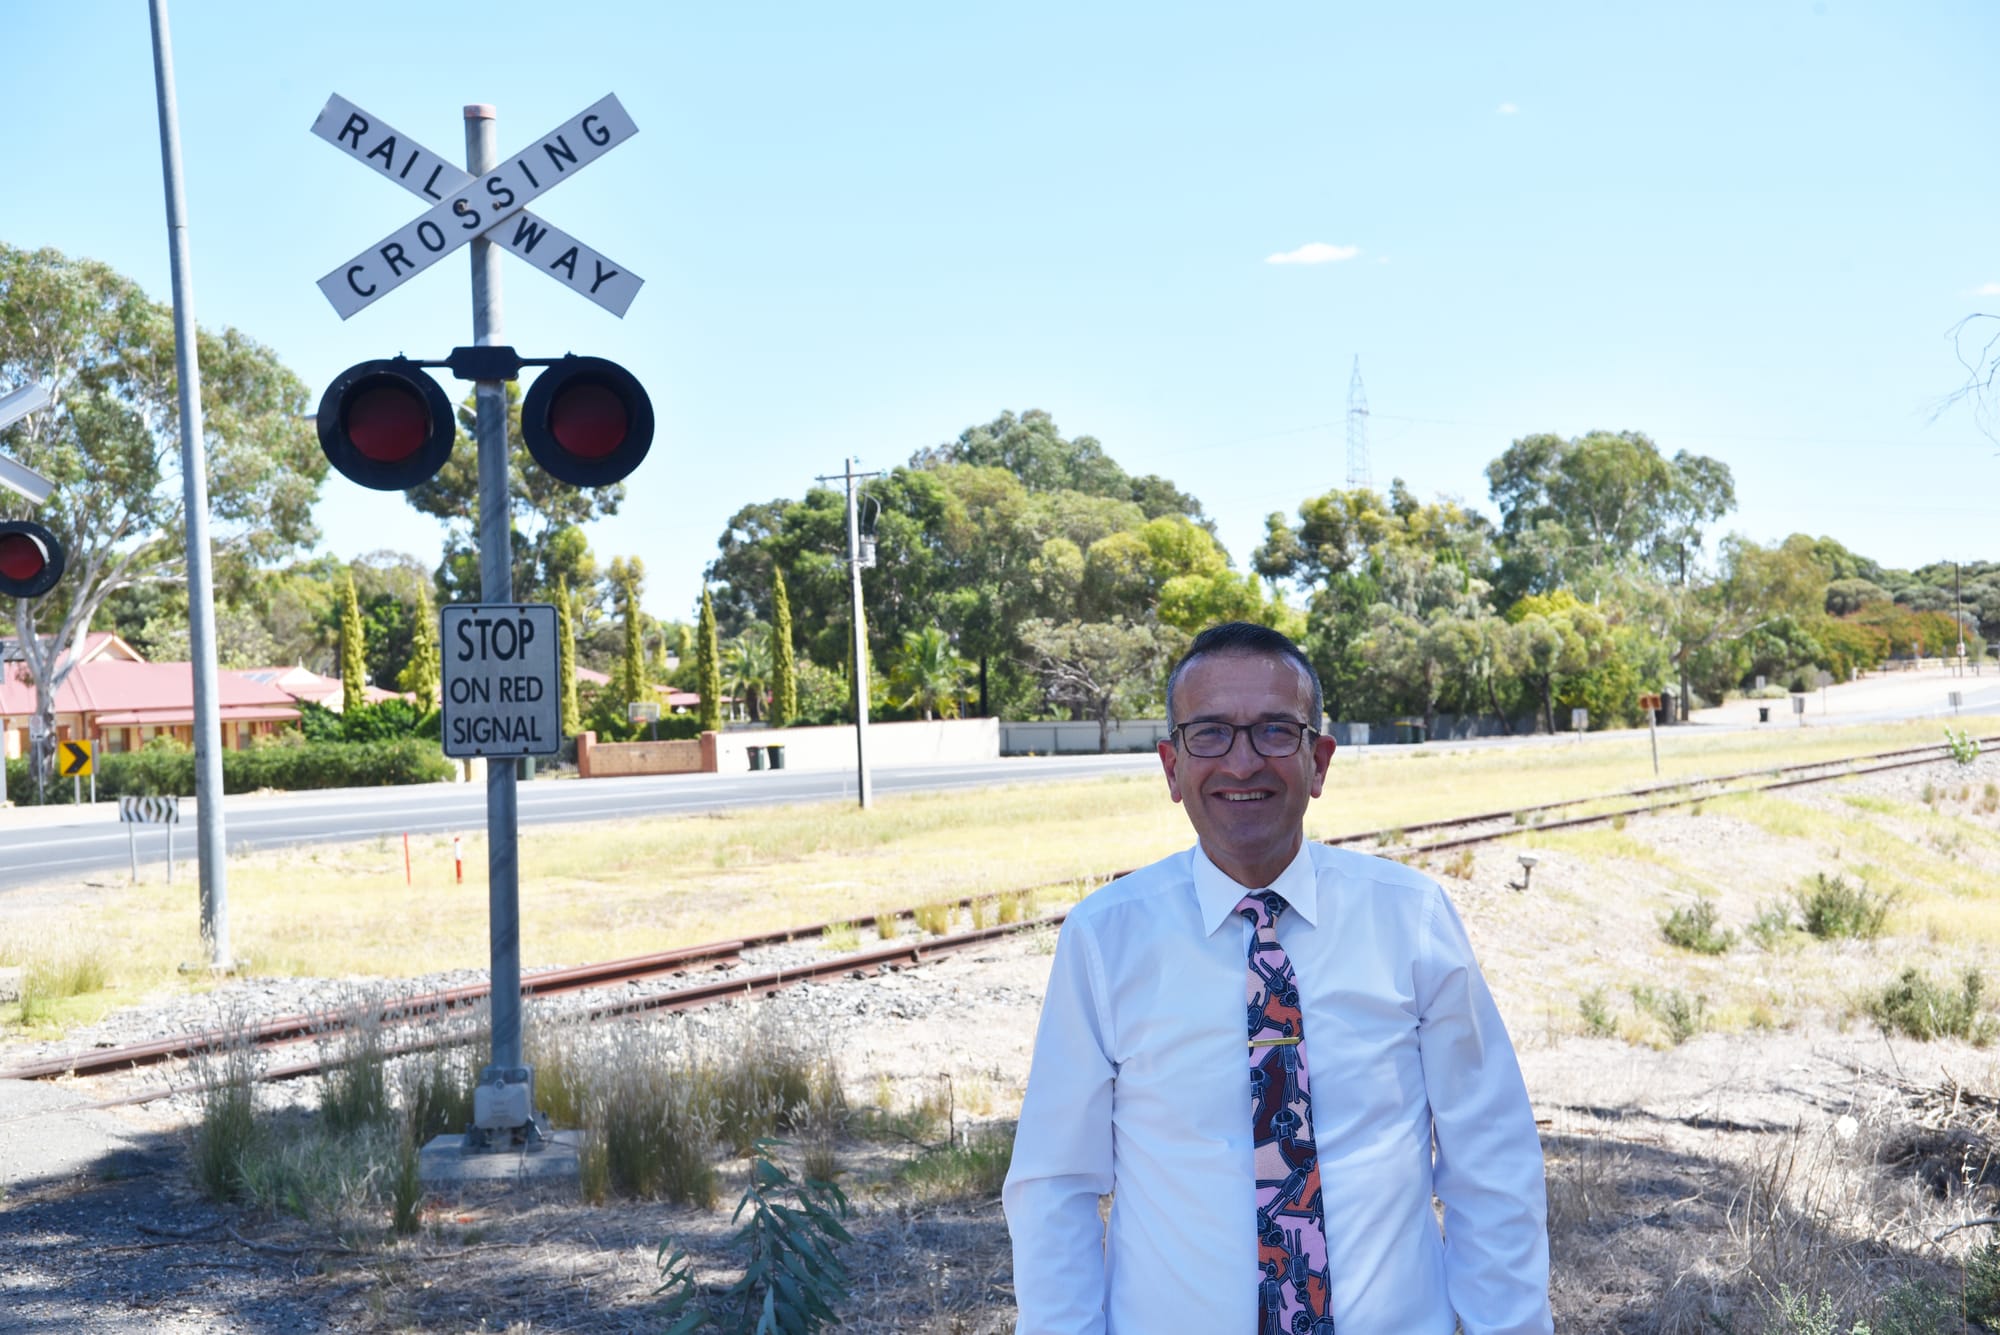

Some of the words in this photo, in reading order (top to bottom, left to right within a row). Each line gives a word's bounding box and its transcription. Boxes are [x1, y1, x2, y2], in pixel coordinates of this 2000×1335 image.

[337, 112, 443, 201] RAIL
[512, 216, 618, 294] WAY
[347, 114, 611, 298] CROSSING
[457, 618, 535, 662] STOP
[450, 677, 490, 704] ON
[500, 676, 543, 703] RED
[453, 716, 542, 745] SIGNAL
